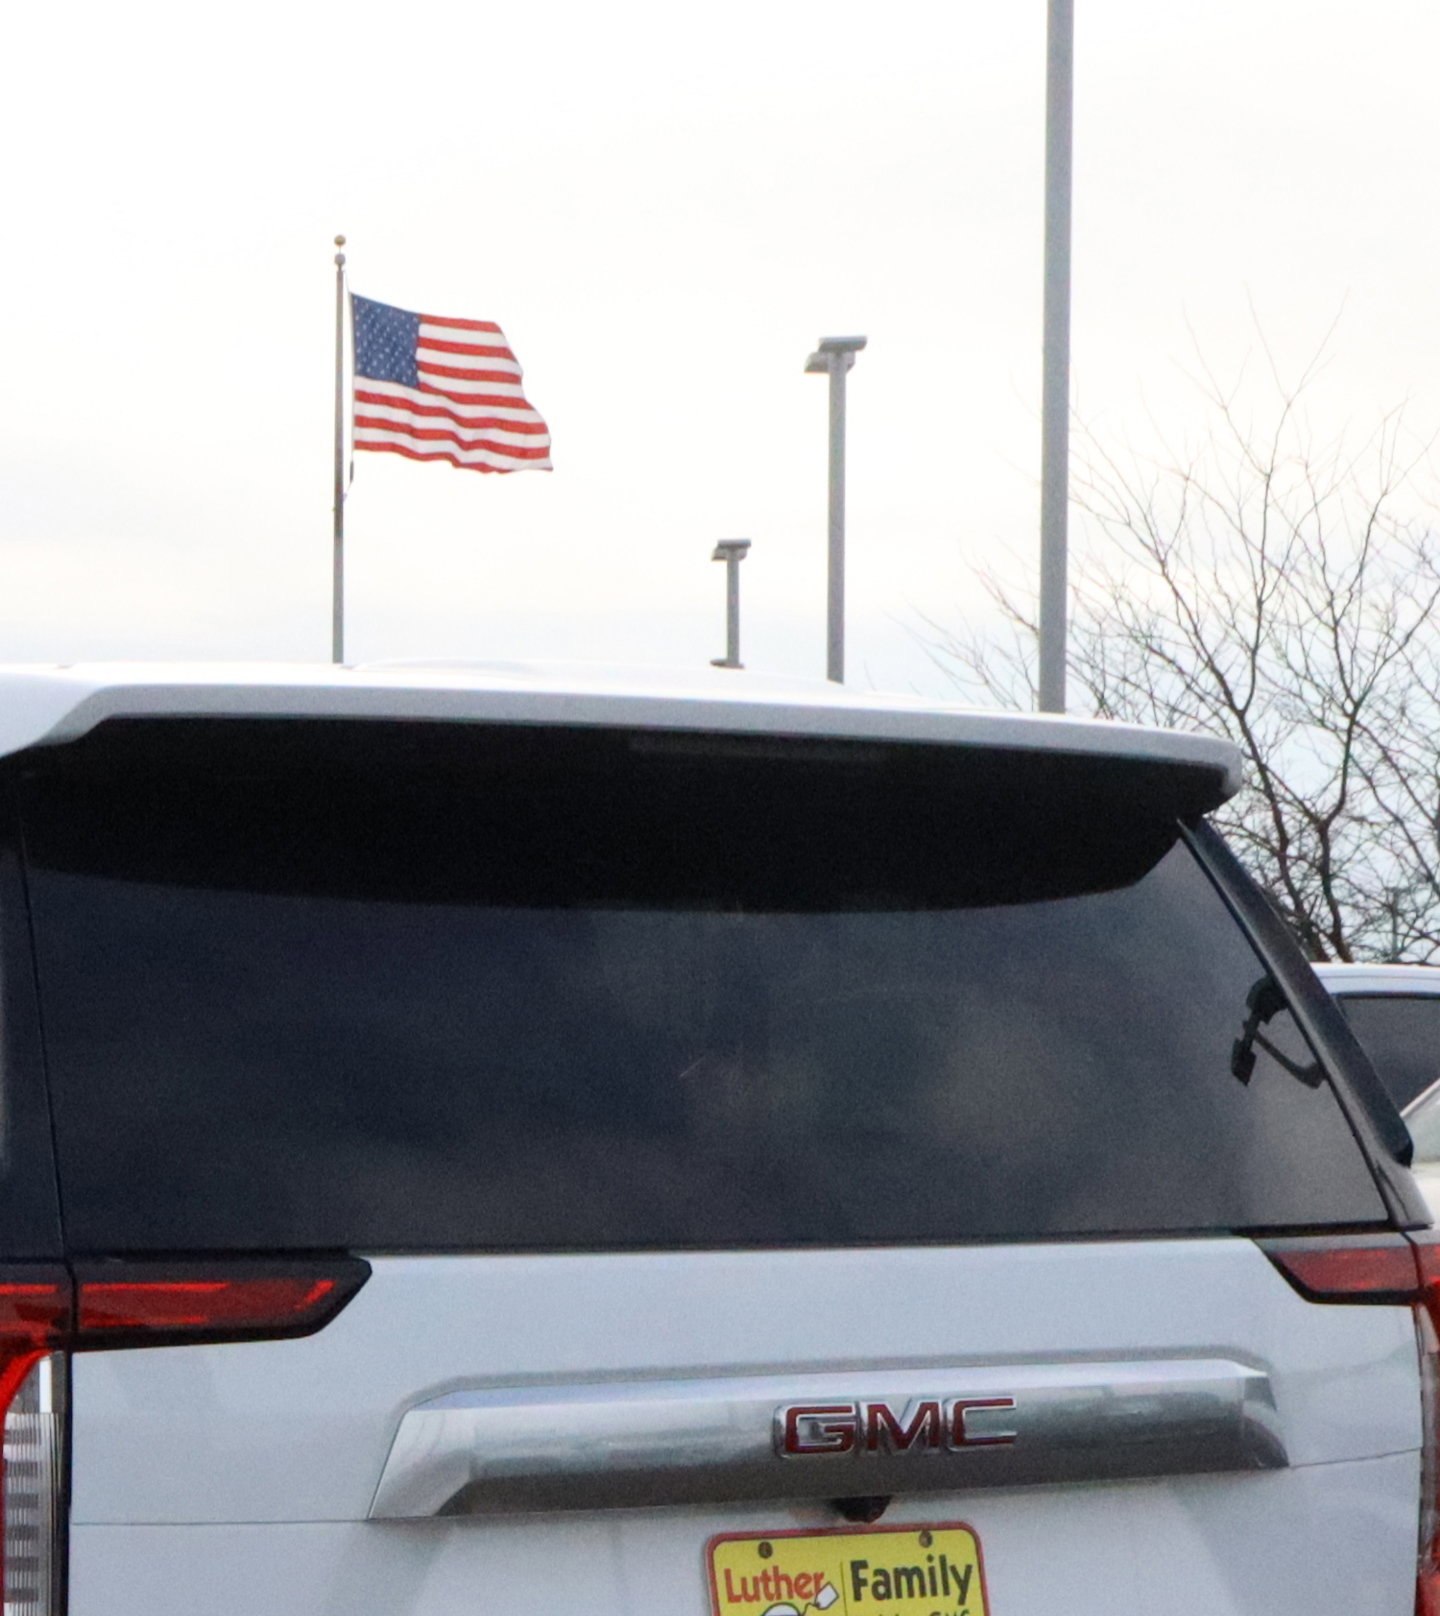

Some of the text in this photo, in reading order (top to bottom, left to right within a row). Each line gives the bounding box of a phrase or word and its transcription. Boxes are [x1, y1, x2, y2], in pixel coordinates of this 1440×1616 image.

[774, 1396, 1018, 1458] GMC
[724, 1554, 973, 1606] Luther Family
